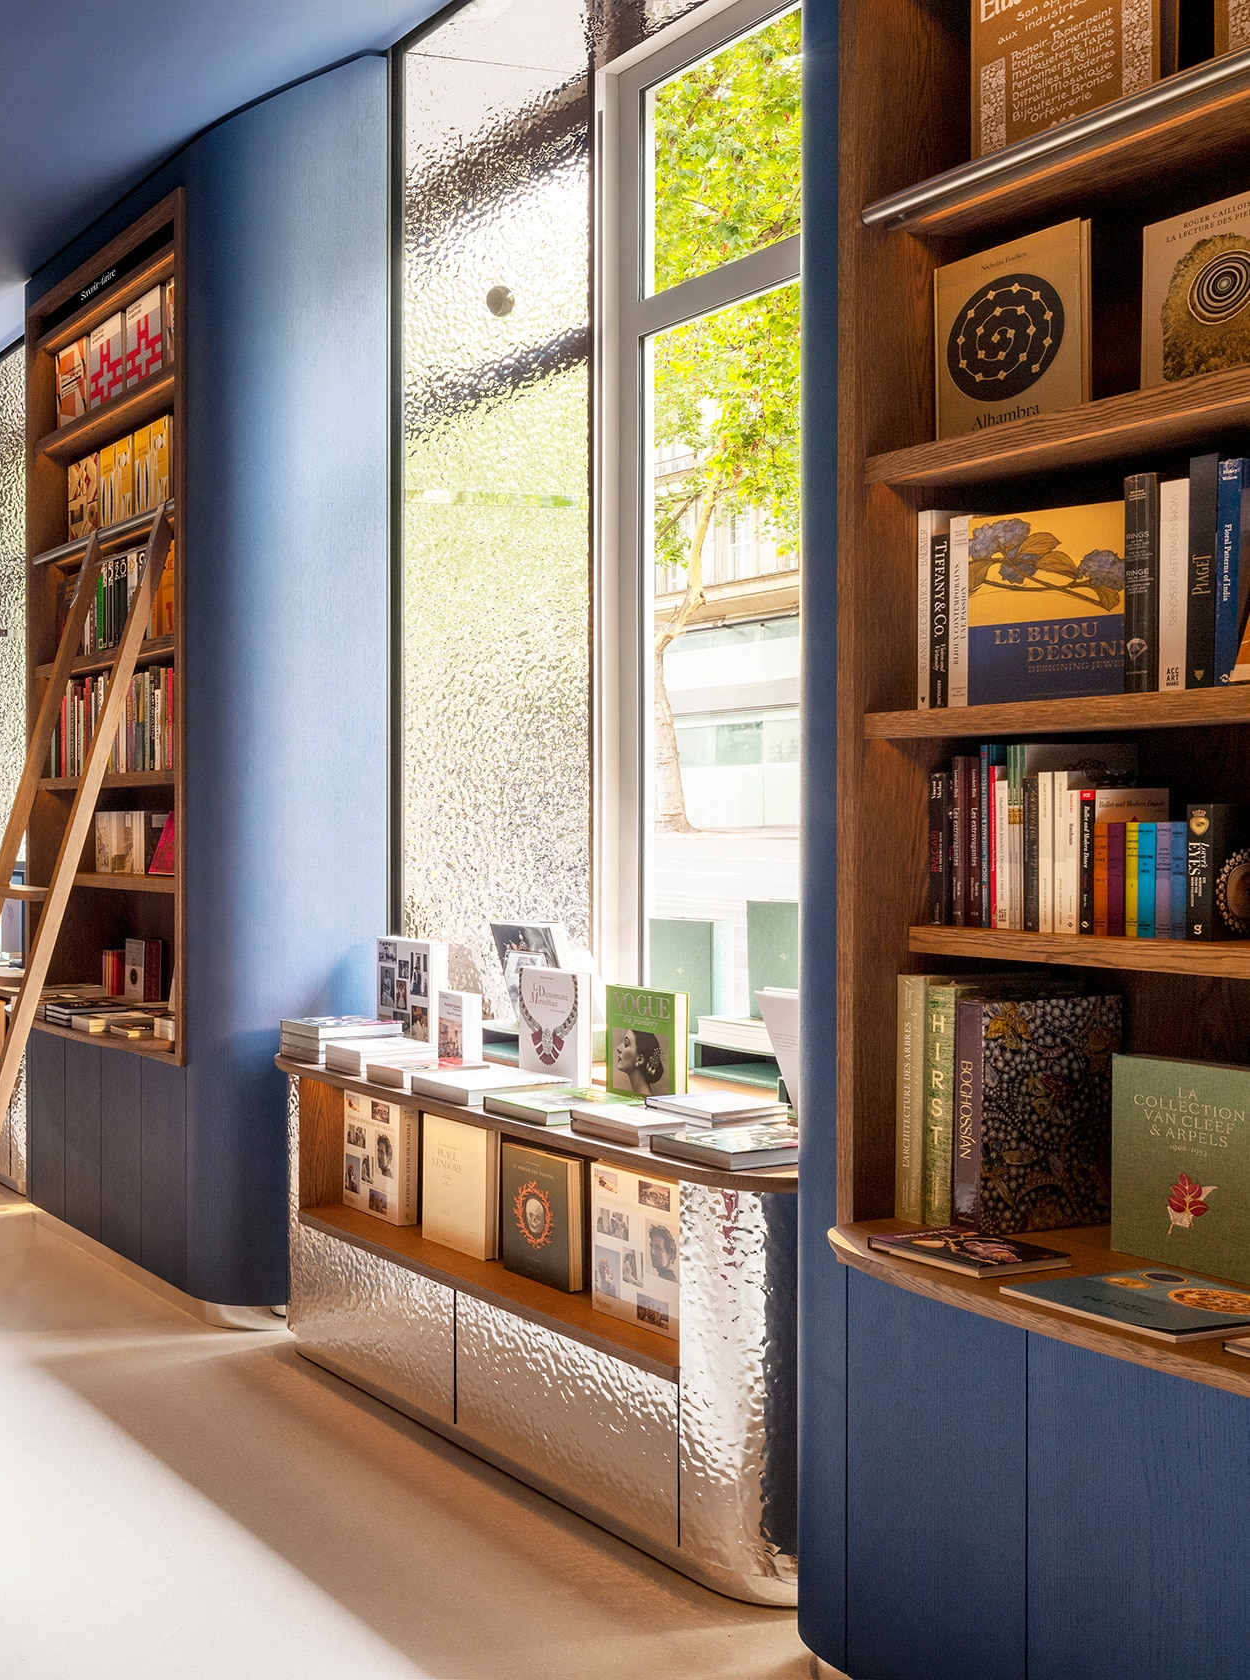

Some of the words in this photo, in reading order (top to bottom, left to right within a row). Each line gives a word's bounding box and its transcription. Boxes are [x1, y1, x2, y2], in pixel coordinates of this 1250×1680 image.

[1016, 7, 1038, 21] Son
[998, 30, 1018, 45] aux
[1083, 28, 1114, 49] Tapis
[1073, 39, 1114, 62] Reliure
[1063, 50, 1115, 77] Broderies
[1071, 71, 1113, 96] Bronze
[1031, 91, 1092, 123] Orfèvrerie
[1178, 223, 1215, 239] LECTURE
[1217, 216, 1232, 226] DES
[1183, 215, 1210, 228] ROGER
[971, 404, 1040, 431] Alhambra
[1170, 494, 1178, 531] WOMEN
[1127, 531, 1149, 540] RINGS
[1223, 524, 1232, 545] Floral
[1168, 533, 1178, 577] JEWELLERY
[1223, 546, 1232, 573] Patterns
[934, 541, 947, 600] TIFFANY
[1126, 568, 1149, 576] RINGE
[1192, 554, 1212, 596] PIAGET
[1168, 580, 1178, 626] DESIGNERS
[1223, 583, 1232, 602] India
[934, 602, 946, 612] &
[994, 628, 1021, 645] LE
[1027, 622, 1098, 644] BIJOU
[1028, 661, 1089, 673] DESIGNING
[970, 820, 978, 866] extravagantes
[1188, 842, 1201, 876] EYES
[614, 992, 670, 1019] VOGUE
[931, 1014, 945, 1145] HIRST
[1178, 1087, 1198, 1101] LA
[1134, 1094, 1244, 1122] COLLECTION
[902, 1084, 910, 1168] L'ARCHITECTURE
[1144, 1108, 1176, 1124] VAN
[1182, 1115, 1235, 1134] CLEEF
[1150, 1124, 1161, 1136] &
[1166, 1127, 1228, 1148] ARPELS
